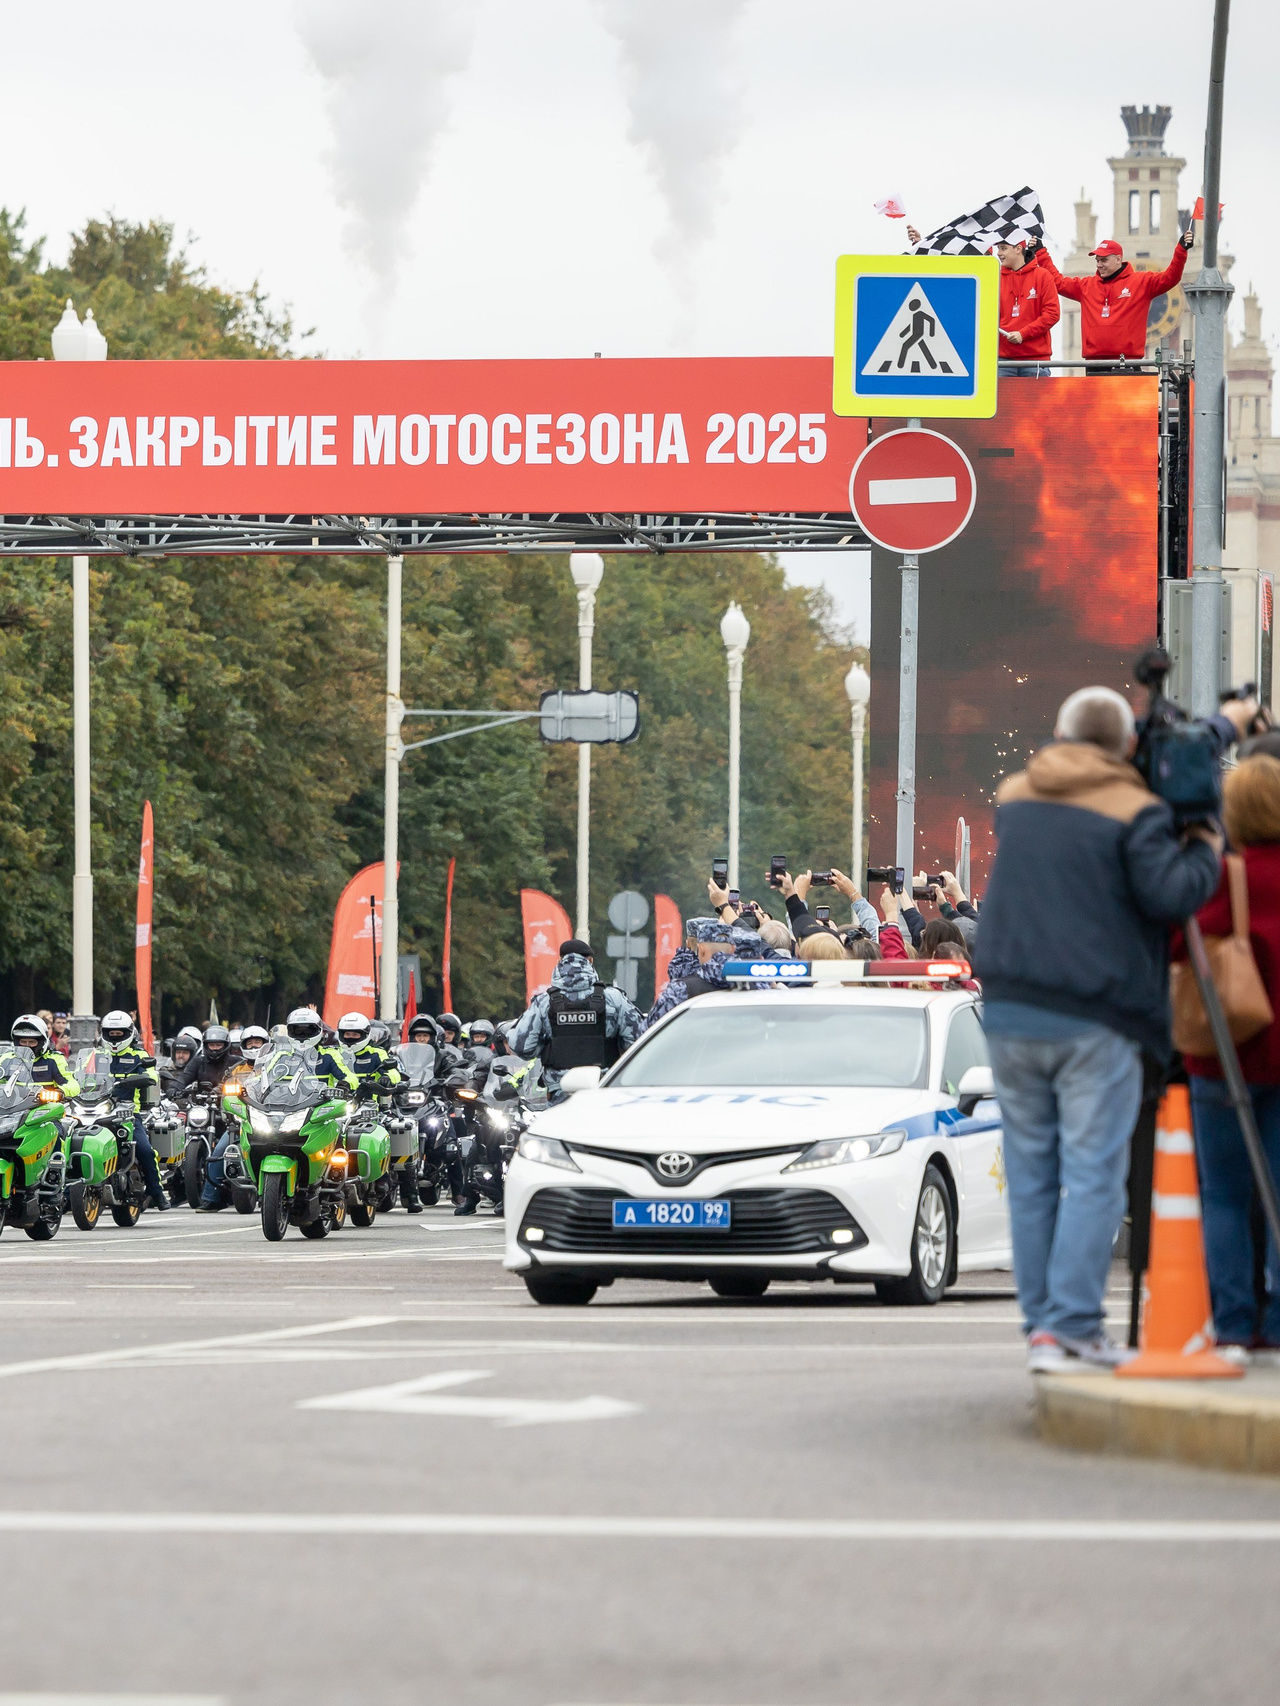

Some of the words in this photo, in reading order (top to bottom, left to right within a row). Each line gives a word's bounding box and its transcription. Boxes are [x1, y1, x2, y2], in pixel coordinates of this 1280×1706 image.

[68, 415, 338, 468] ЗАКРЫТИЕ
[352, 412, 690, 466] МОТОСЕЗОНА
[705, 412, 827, 464] 2025
[559, 1013, 595, 1023] ОМОН
[646, 1203, 695, 1224] 1820
[703, 1203, 724, 1219] 99
